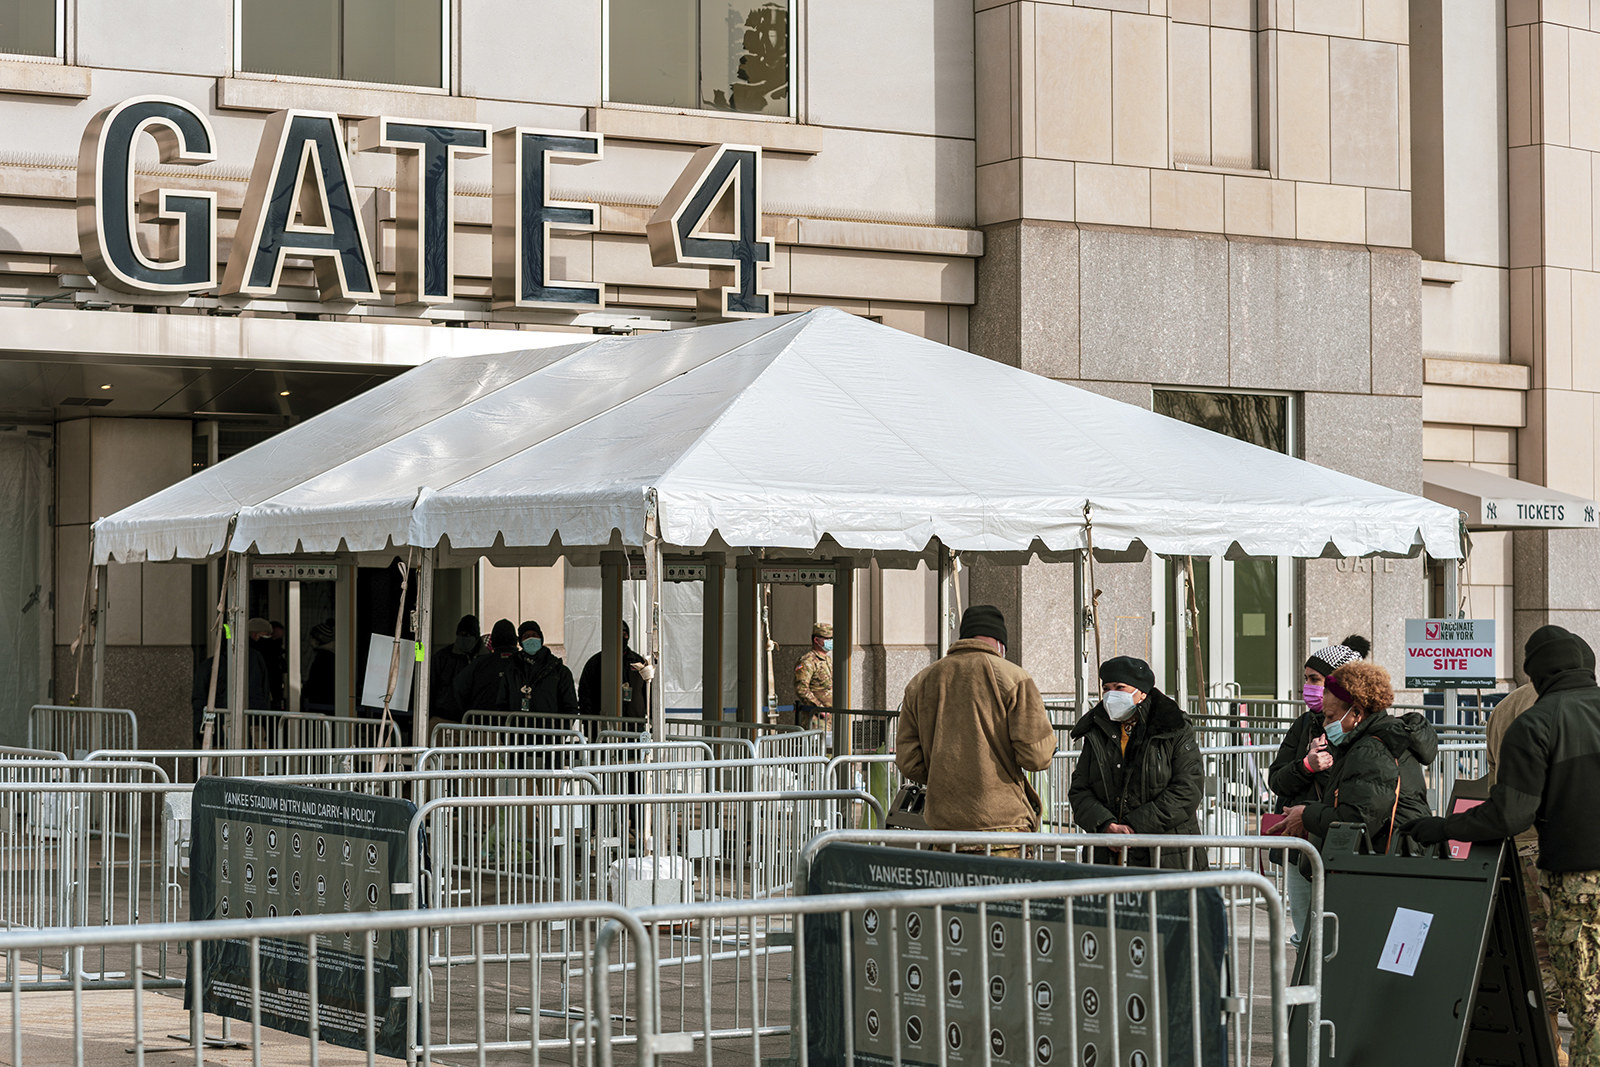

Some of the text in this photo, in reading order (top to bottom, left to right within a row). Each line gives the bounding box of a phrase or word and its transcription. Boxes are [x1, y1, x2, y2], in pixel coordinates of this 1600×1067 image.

[84, 95, 775, 317] GATE 4
[1516, 504, 1564, 521] TICKETS
[1440, 622, 1474, 632] VACCINATE
[1440, 631, 1474, 641] NEW YORK
[1408, 647, 1493, 658] VACCINATION
[1433, 658, 1468, 671] SITE
[224, 791, 249, 808] YANKEE
[249, 795, 279, 811] STADIUM
[279, 798, 301, 814] ENTRY
[302, 801, 317, 816] AND
[317, 805, 350, 820] CARRY-IN
[351, 809, 376, 824] POLICY
[868, 864, 913, 886] YANKEE
[914, 869, 965, 888] STADIUM
